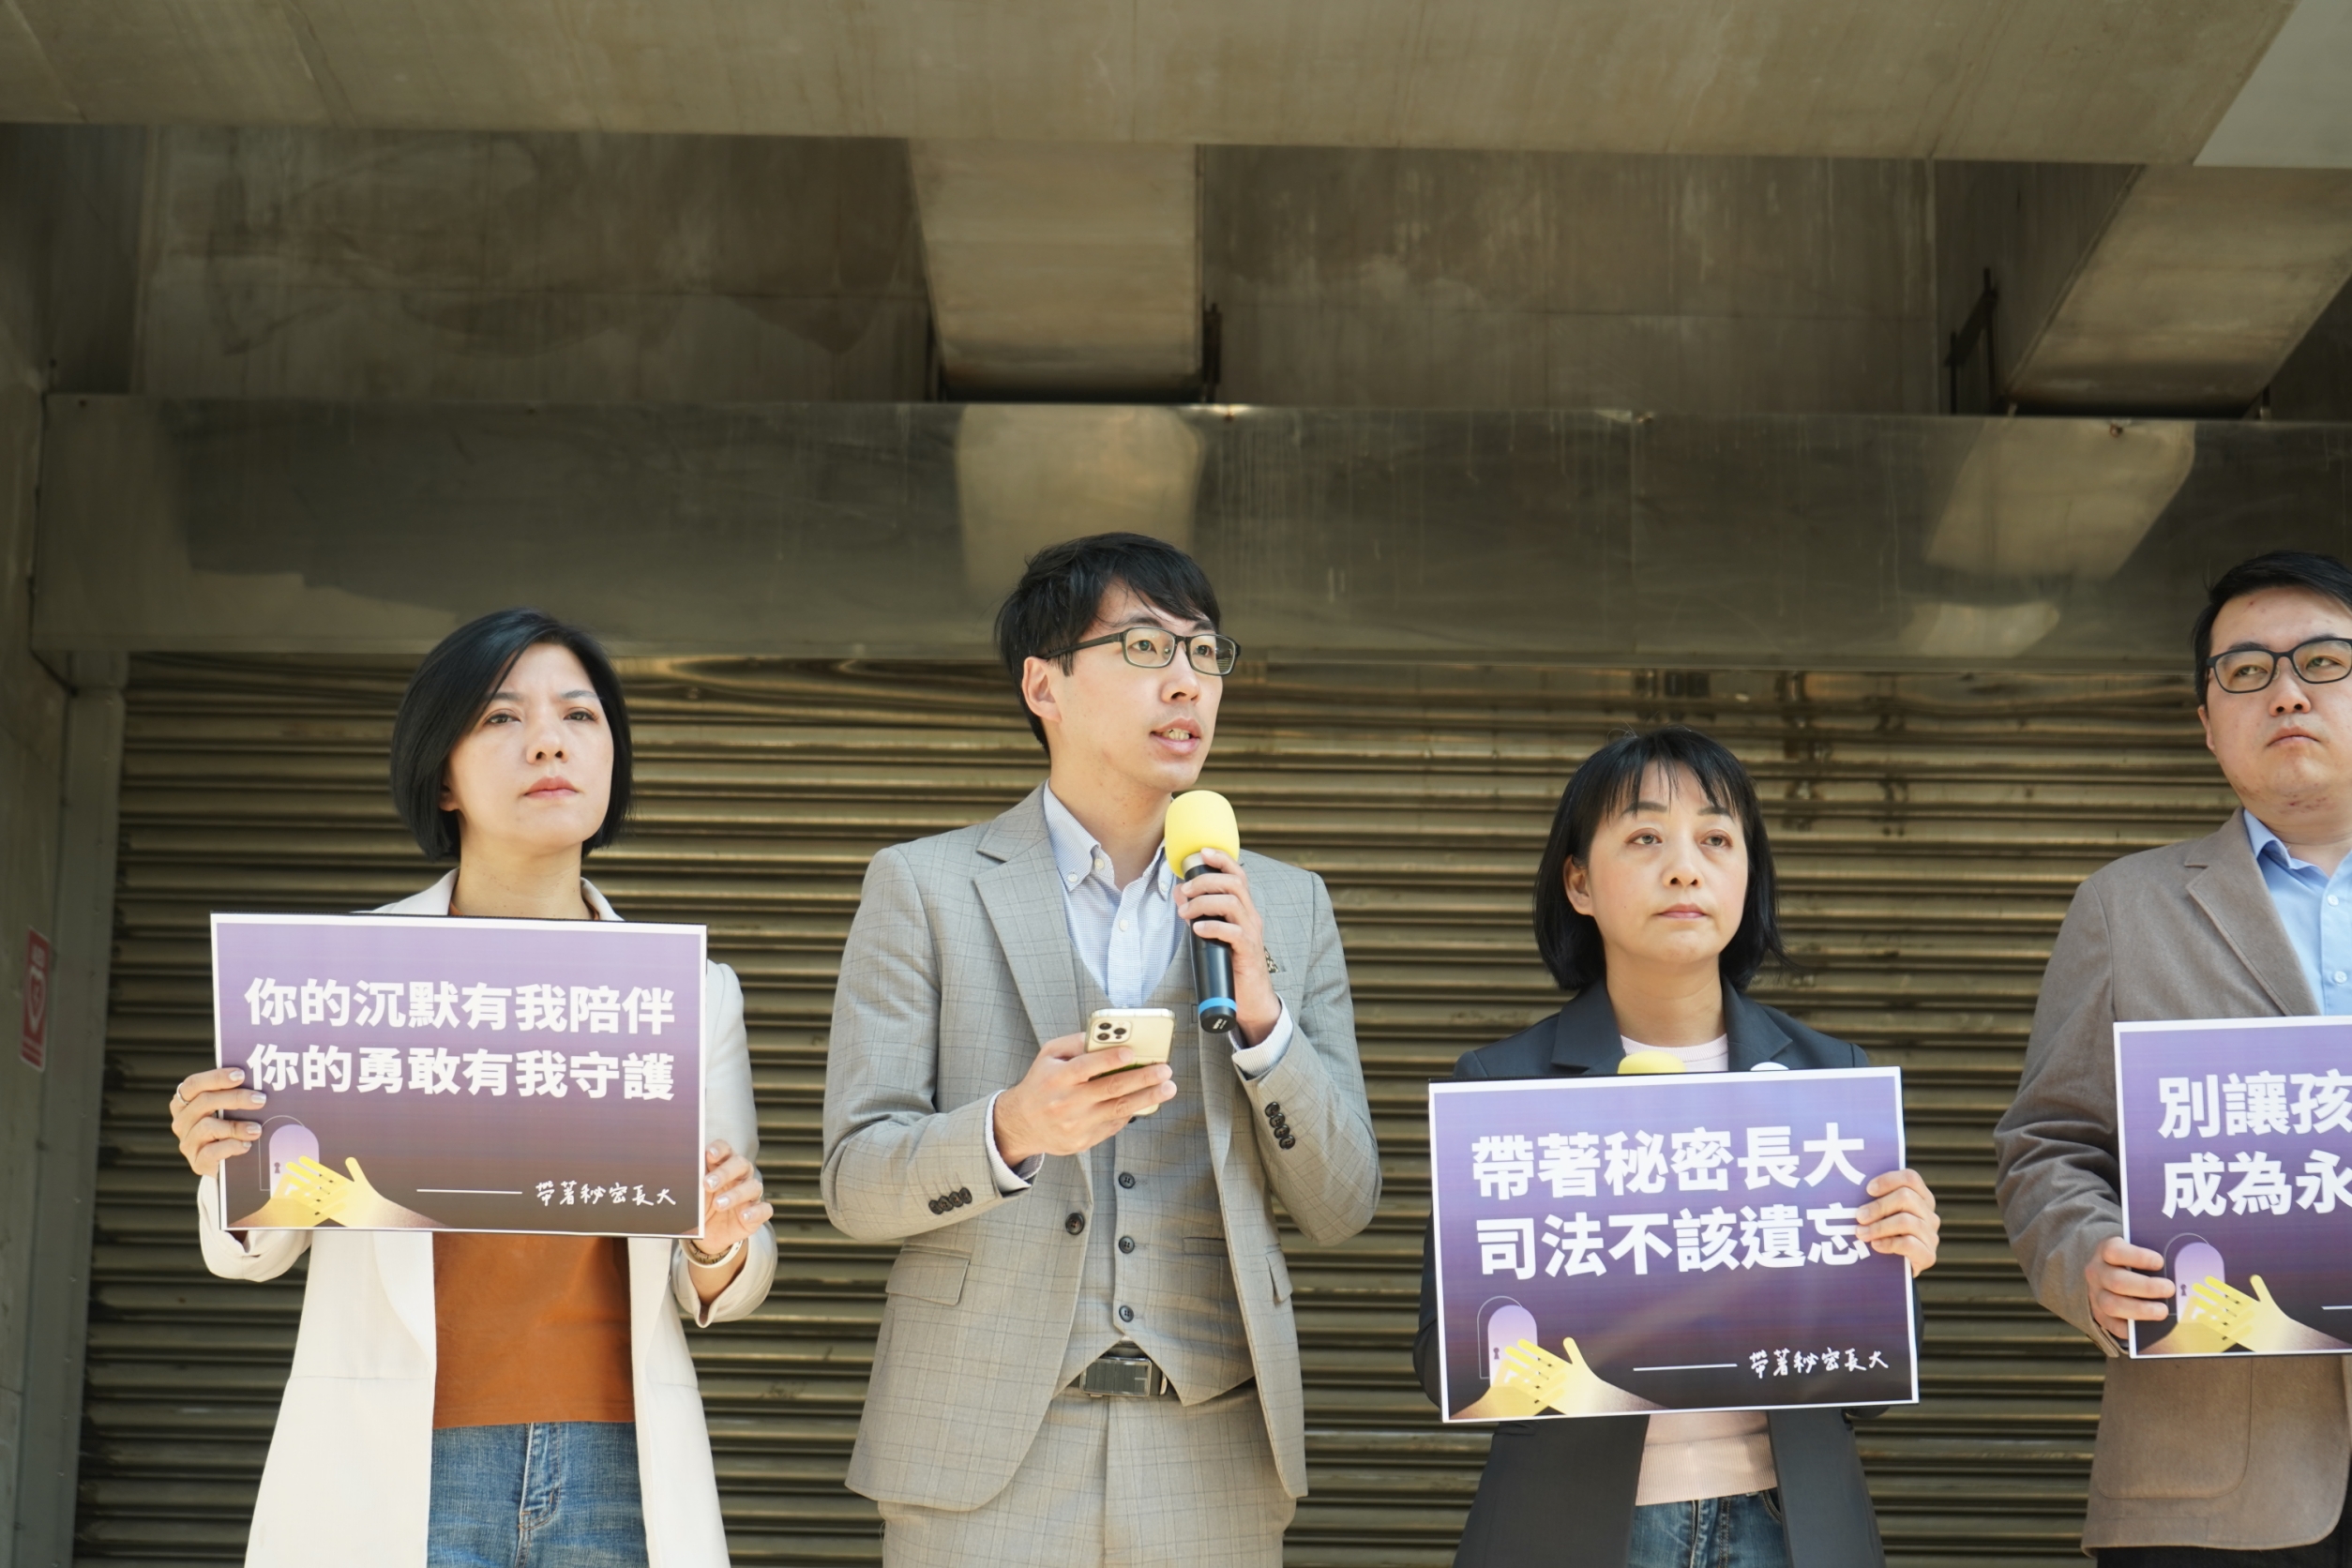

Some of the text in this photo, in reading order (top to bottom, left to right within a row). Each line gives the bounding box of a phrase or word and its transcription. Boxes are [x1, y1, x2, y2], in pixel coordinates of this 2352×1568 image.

[245, 977, 675, 1035] 你的沉默有我陪伴
[247, 1044, 674, 1101] 你的勇敢有我守護
[2158, 1068, 2352, 1138] 別讓孩
[535, 1180, 676, 1207] 帶著秘密長大
[1471, 1123, 1866, 1200] 帶著秘密長大
[2162, 1149, 2352, 1219] 成為永
[1477, 1202, 1872, 1280] 司法不該遺忘
[1749, 1347, 1889, 1379] 帶著秘密長大
